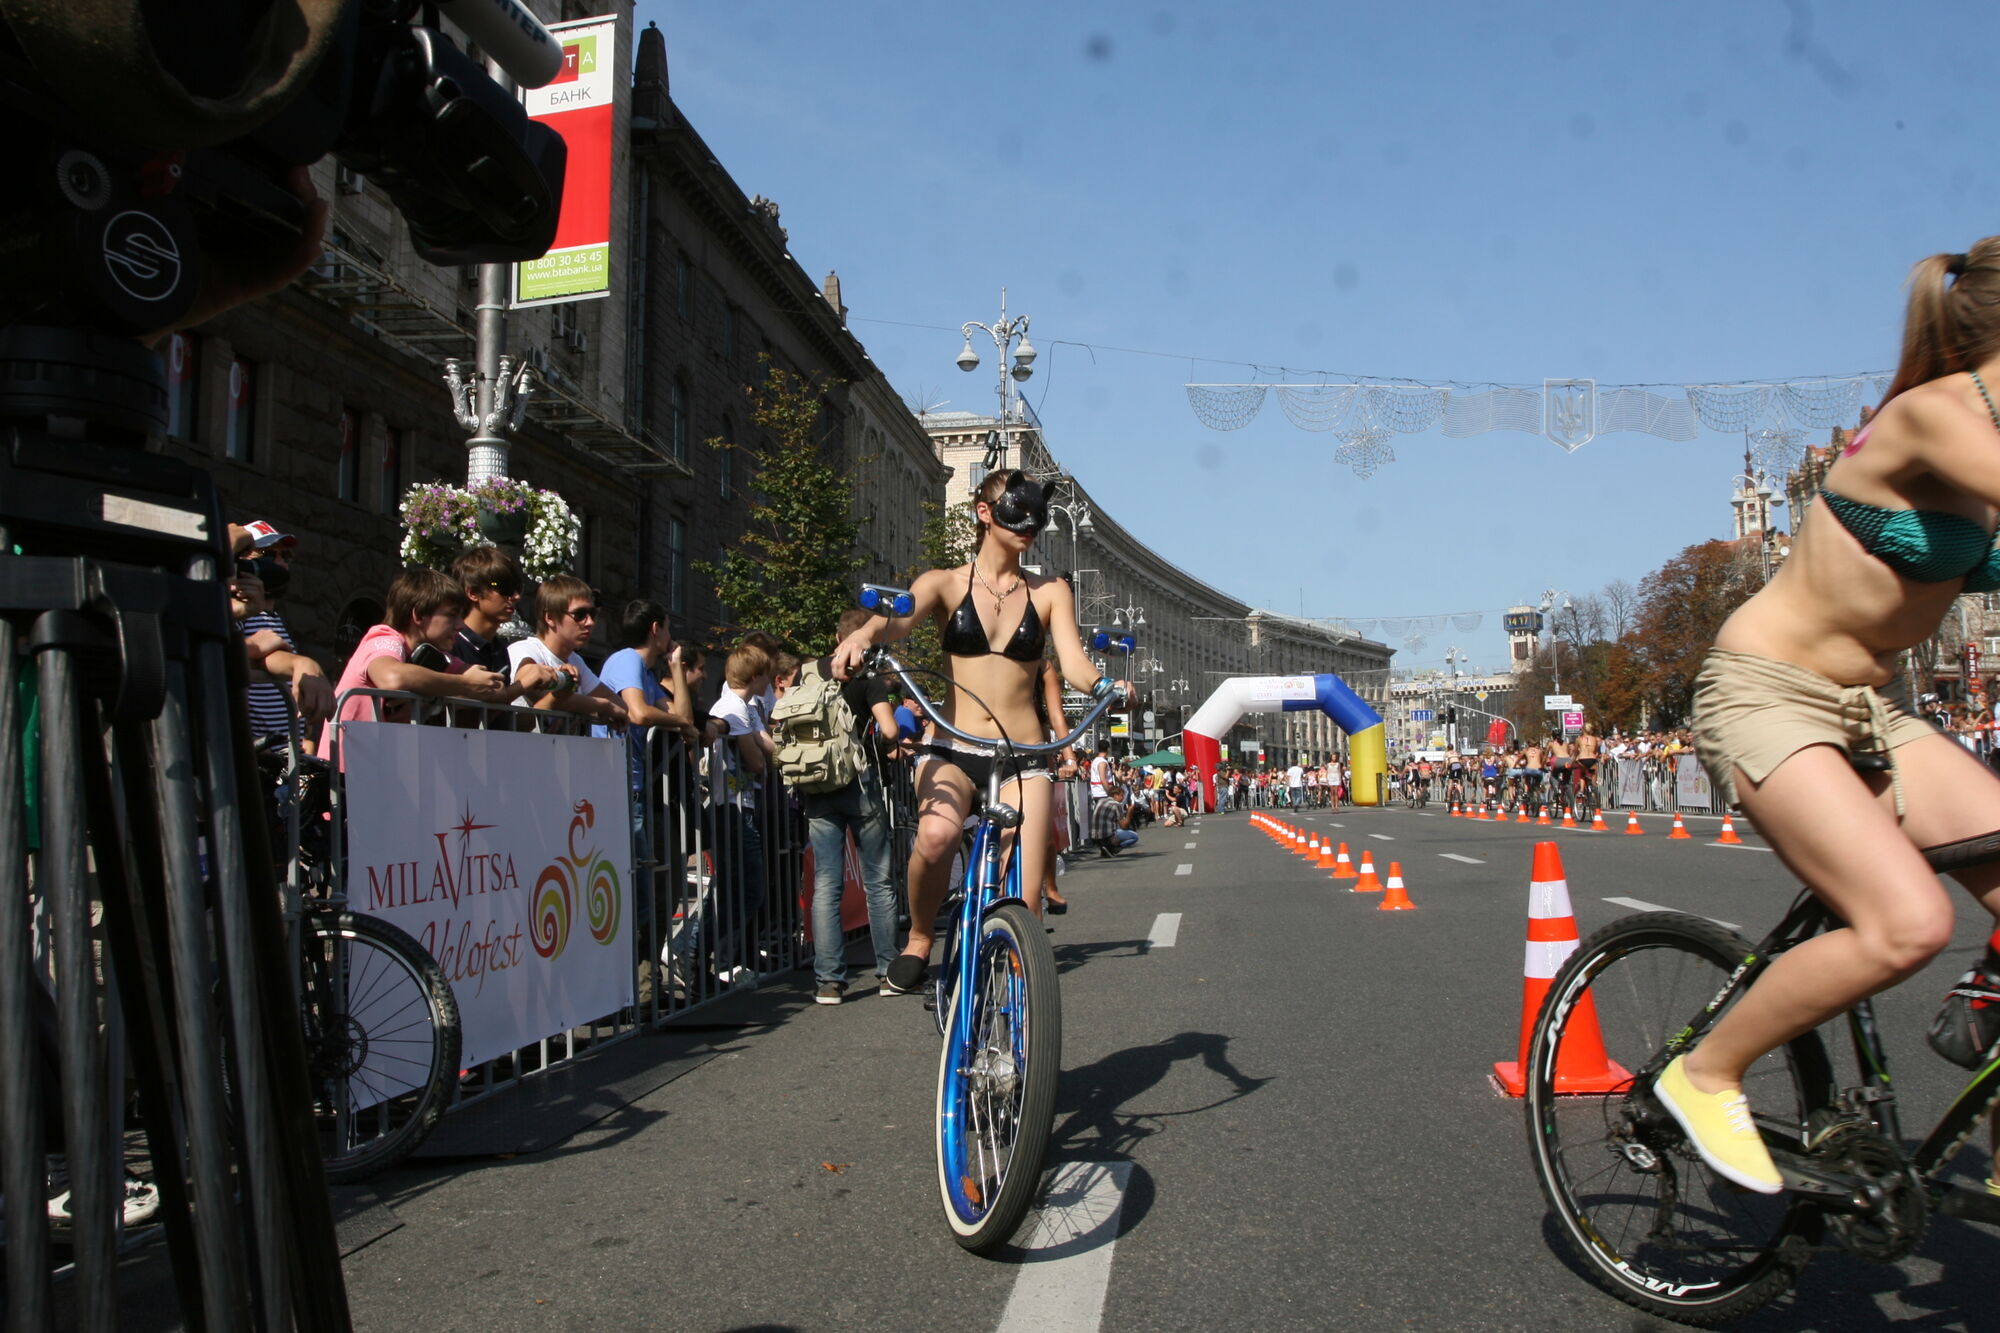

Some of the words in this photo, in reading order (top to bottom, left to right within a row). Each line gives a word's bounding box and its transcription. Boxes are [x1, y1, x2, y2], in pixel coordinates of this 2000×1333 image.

[565, 51, 593, 68] ТА
[550, 86, 592, 105] БАНК
[527, 260, 535, 271] 0
[537, 257, 556, 269] 800
[558, 255, 572, 267] 30
[573, 252, 587, 264] 45
[589, 250, 602, 262] 45
[527, 264, 603, 281] www.btabank.ua
[366, 833, 520, 911] MILAVITSA
